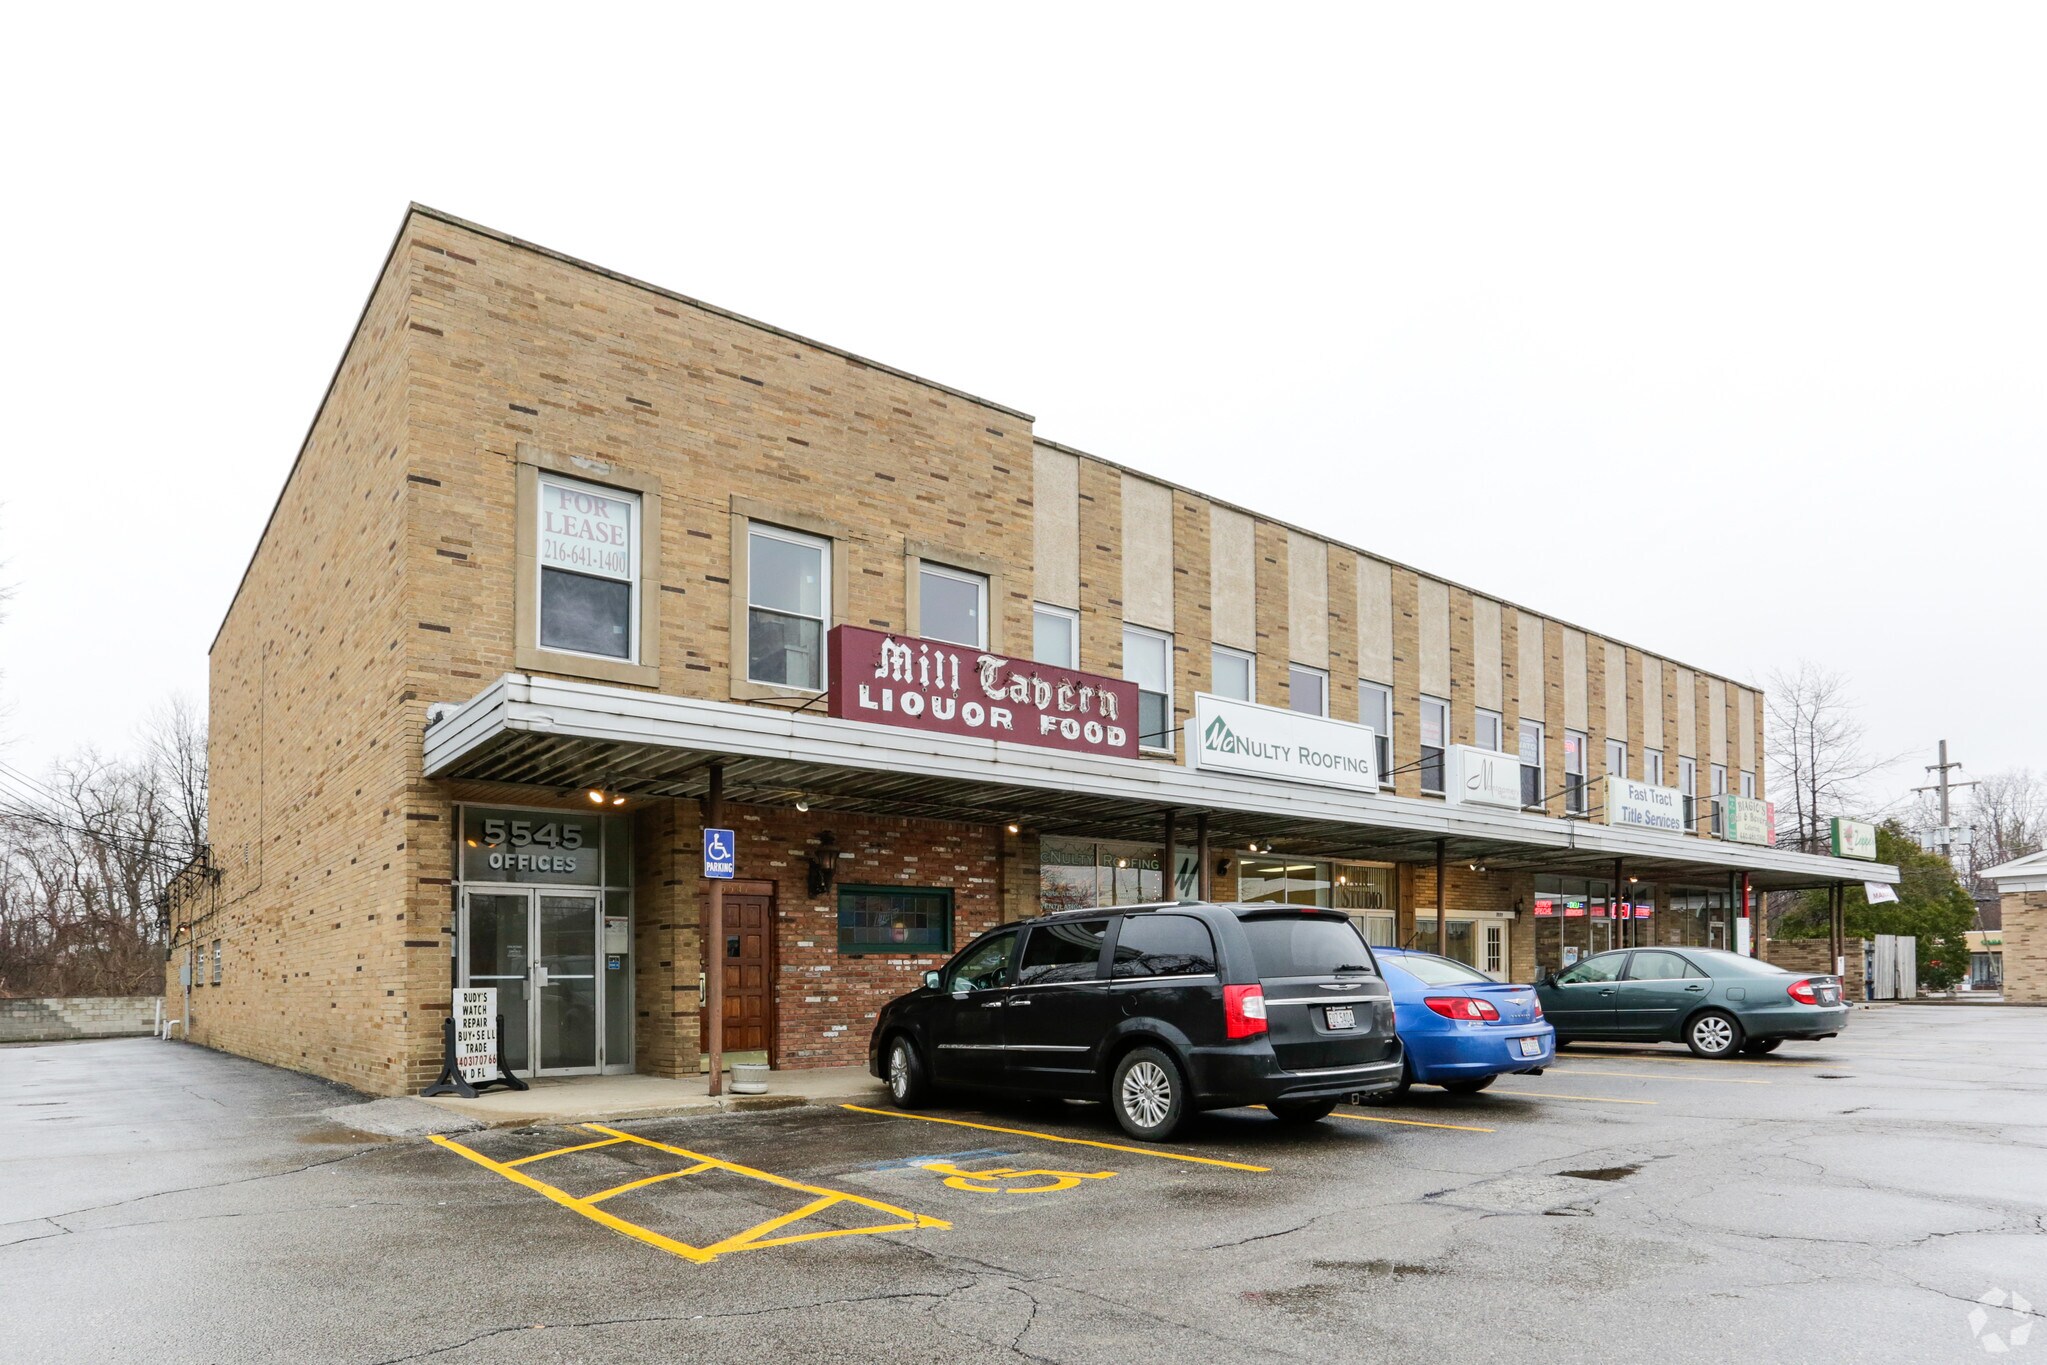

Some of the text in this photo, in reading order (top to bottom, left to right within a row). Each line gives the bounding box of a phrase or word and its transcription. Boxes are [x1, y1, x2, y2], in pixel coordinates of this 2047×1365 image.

[560, 490, 609, 519] FOR
[544, 511, 625, 547] LEASE
[544, 538, 627, 573] 216-641-1400
[874, 637, 1119, 721] Mill Tavern
[1040, 713, 1127, 747] FOOD
[1299, 746, 1369, 774] ROOFING
[1628, 784, 1673, 806] Fast Tract
[1622, 806, 1680, 830] Title Services
[483, 819, 583, 850] 5545
[489, 852, 577, 872] OFFICES
[706, 861, 733, 873] PARKING
[1342, 887, 1383, 909] STUDIO
[463, 992, 488, 1003] RUDY'S
[462, 1005, 487, 1016] WATCH
[463, 1018, 488, 1028] REPAIR
[466, 1043, 487, 1053] TRADE
